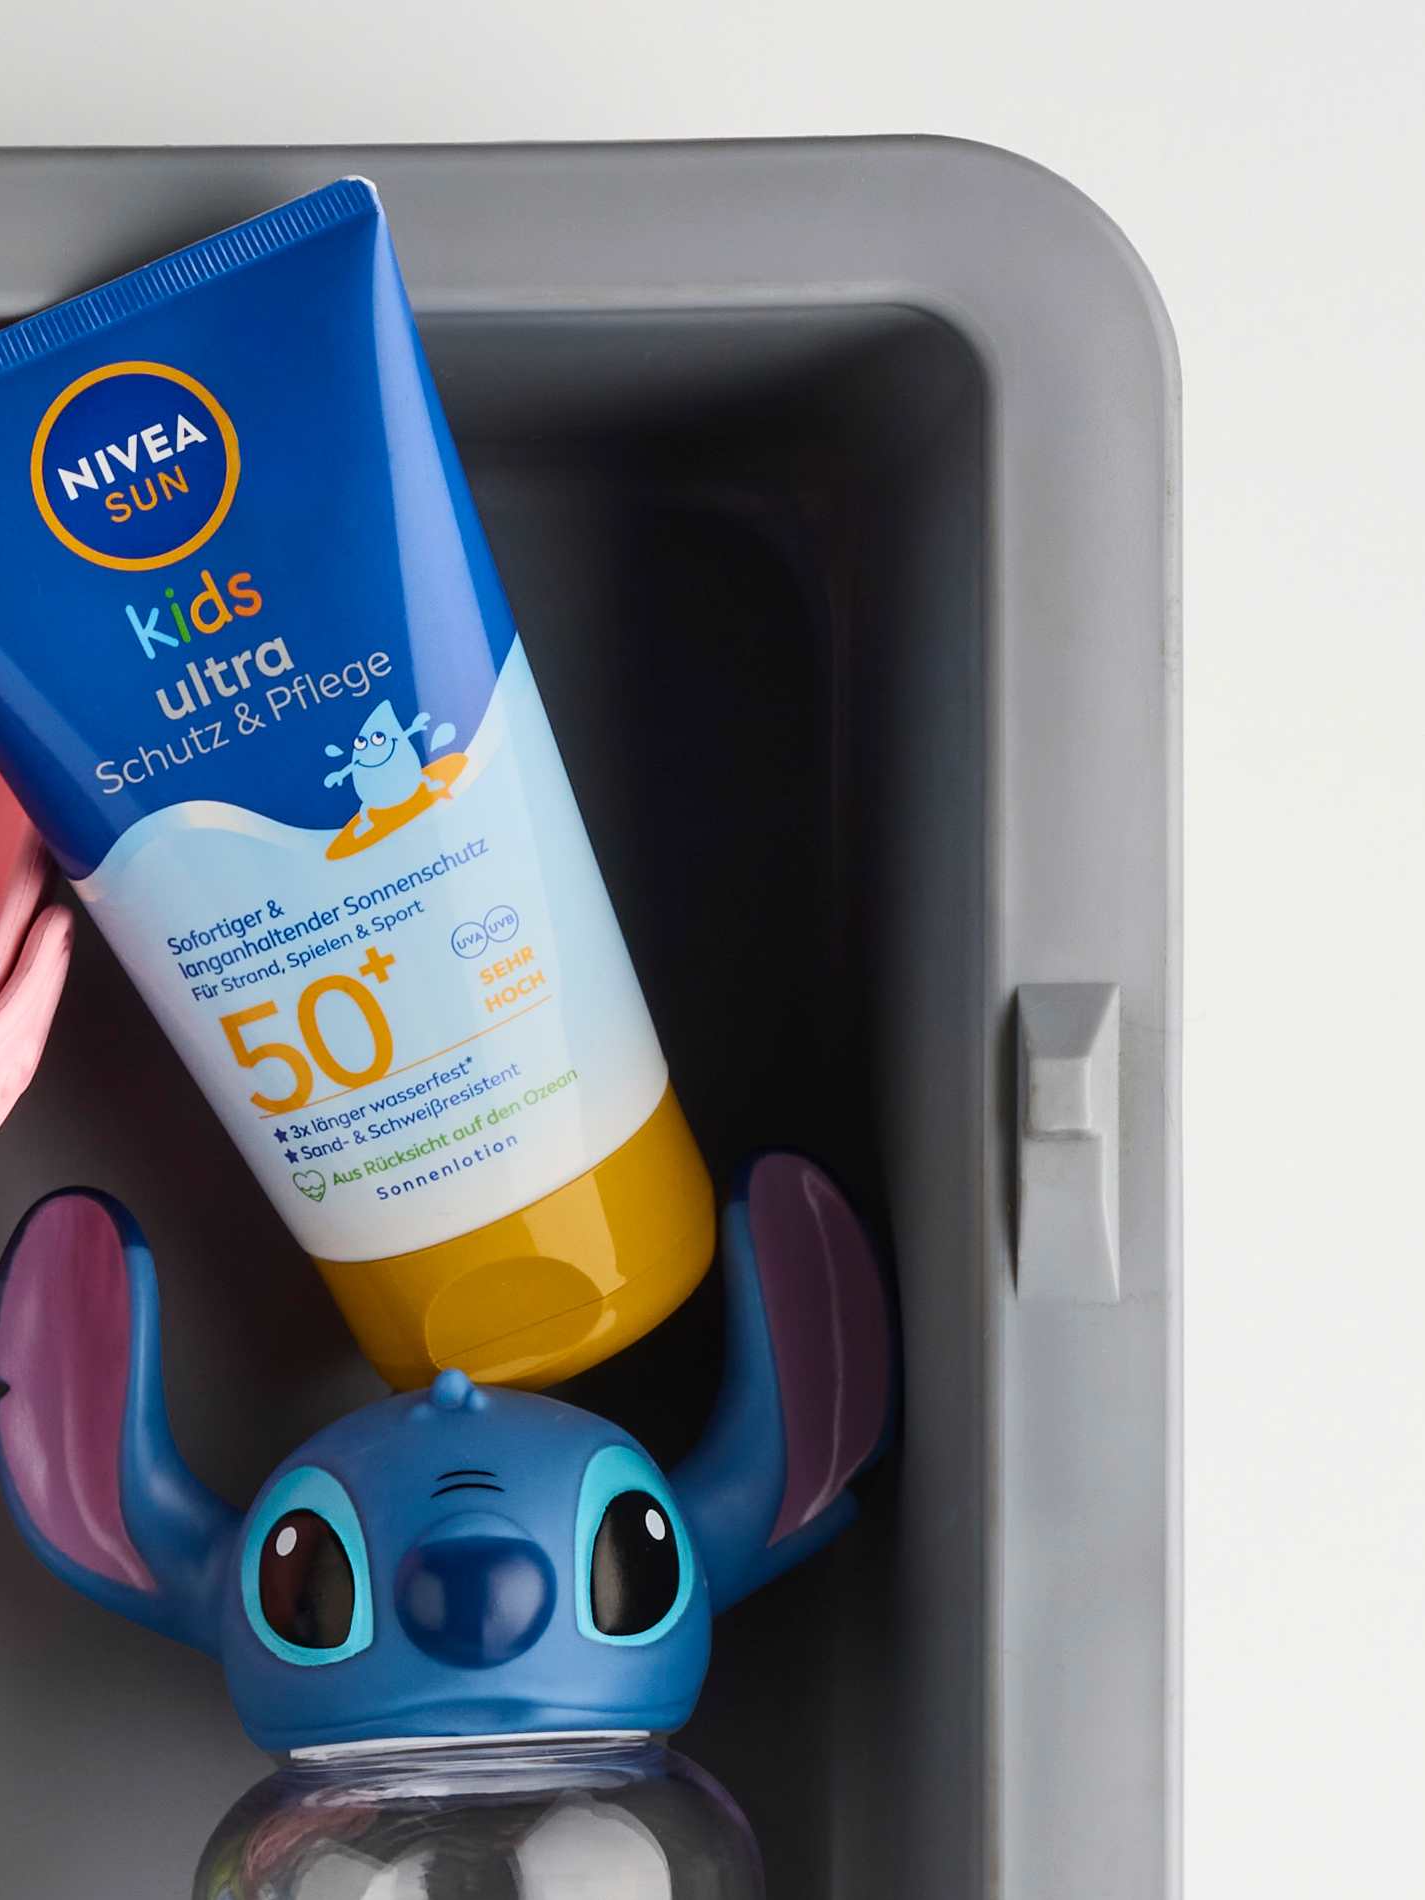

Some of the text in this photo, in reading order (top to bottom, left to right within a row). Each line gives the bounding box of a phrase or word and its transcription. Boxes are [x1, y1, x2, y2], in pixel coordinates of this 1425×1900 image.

[57, 413, 208, 500] NIVEA
[104, 465, 189, 523] SUN
[125, 569, 263, 660] kids
[155, 636, 295, 721] ultra
[95, 651, 392, 795] Schutz & Pflege
[167, 899, 286, 957] Sofortiger &
[178, 837, 490, 980] langanhaltender Sonnenschutz
[191, 899, 425, 1001] Für Strand, Spielen & Sport
[456, 913, 516, 950] UVA UVB
[479, 945, 534, 985] SEHR
[485, 969, 547, 1013] HOCH
[218, 945, 396, 1116] 50+
[289, 1124, 312, 1140] 3x
[311, 1104, 368, 1134] länger
[300, 1062, 522, 1162] Sand- & Schweißresistent
[333, 1068, 579, 1187] Aus Rücksicht auf den Ozean
[376, 1133, 519, 1201] Sonnenlotion
